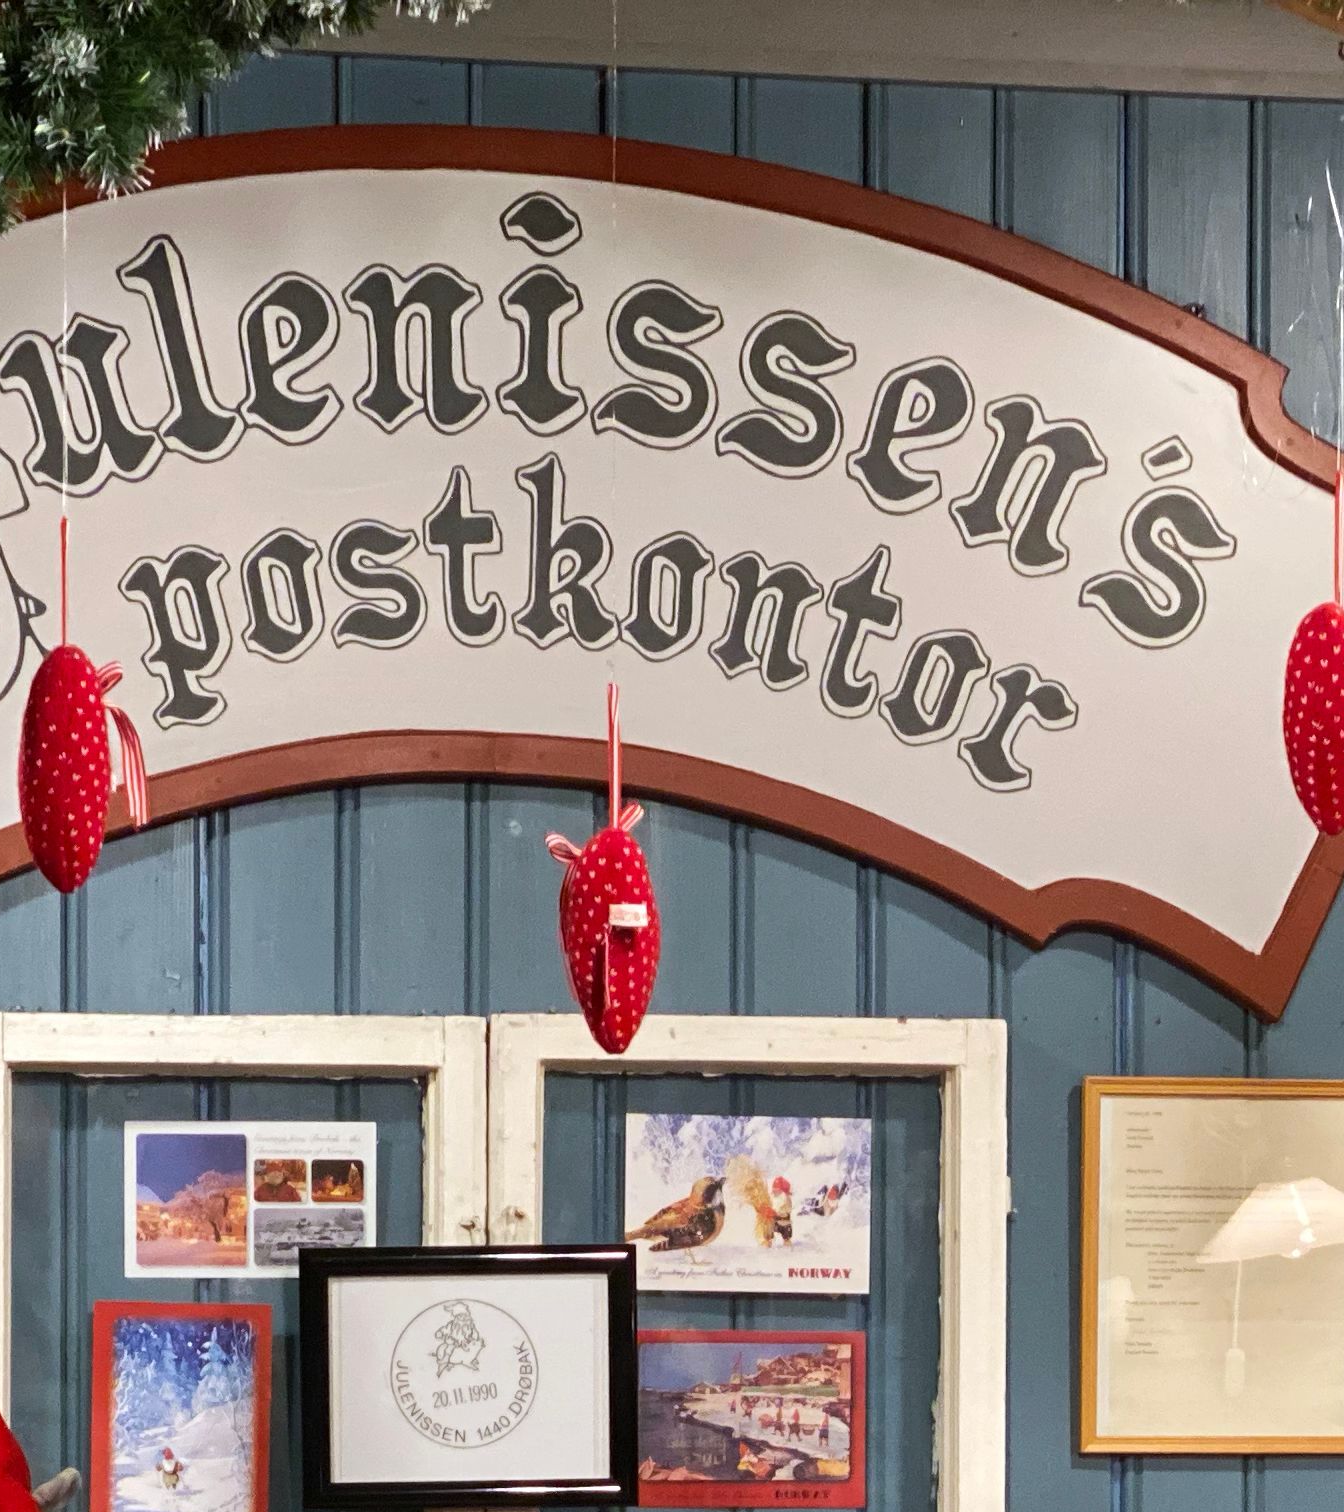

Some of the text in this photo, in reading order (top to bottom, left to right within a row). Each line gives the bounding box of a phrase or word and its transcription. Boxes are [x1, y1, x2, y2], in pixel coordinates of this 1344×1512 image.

[118, 452, 1079, 793] postkontor
[787, 1267, 852, 1280] NORWAY
[396, 1340, 533, 1443] JULENISSEN 1440 DRØBAK
[432, 1382, 498, 1409] 20.11.1990
